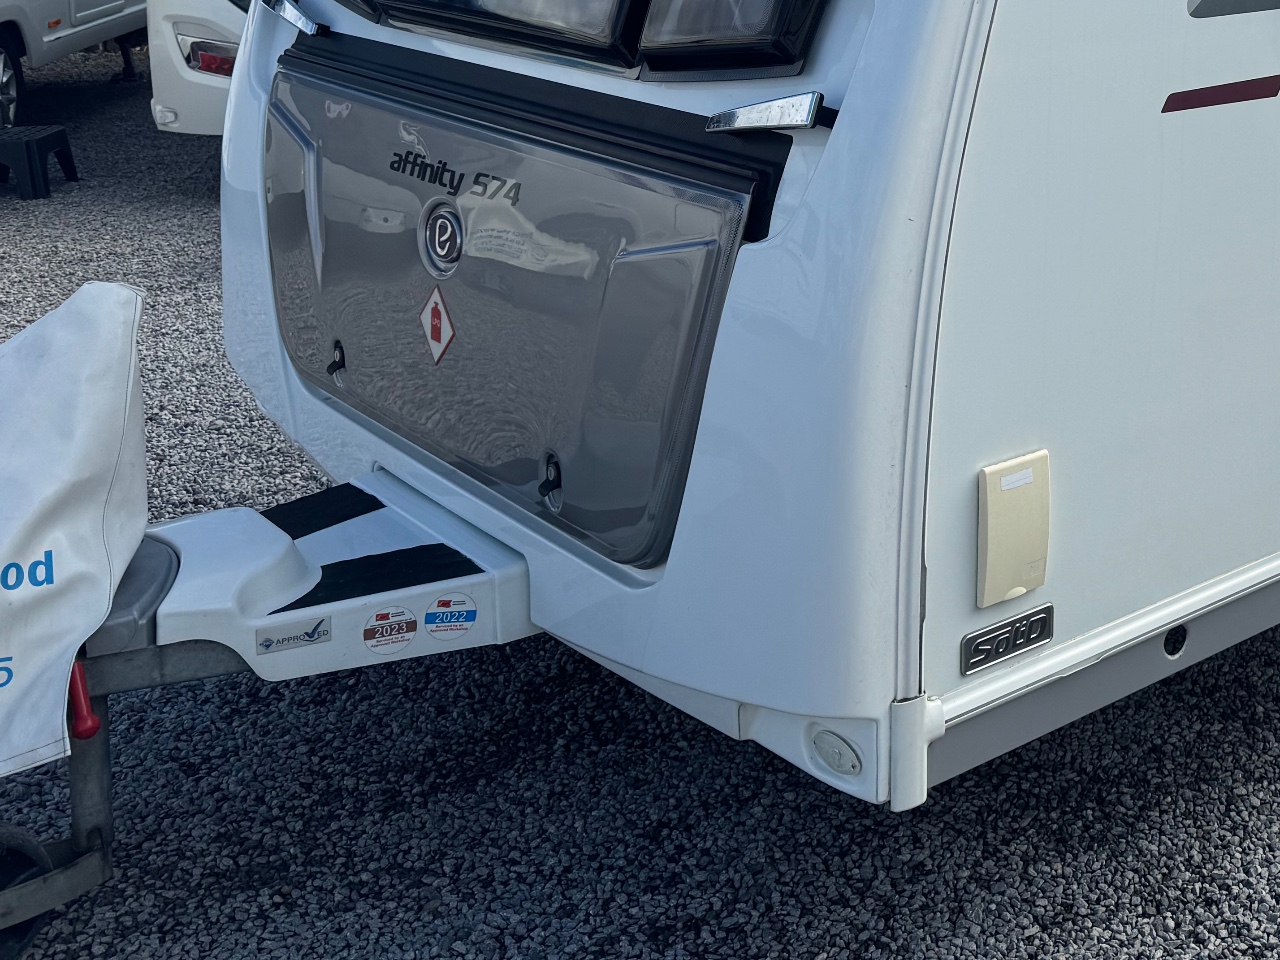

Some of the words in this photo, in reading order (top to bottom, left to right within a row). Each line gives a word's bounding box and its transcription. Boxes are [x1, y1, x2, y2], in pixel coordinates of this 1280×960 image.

[389, 150, 466, 196] affinity
[470, 172, 522, 207] 574
[435, 611, 467, 623] 2022
[374, 623, 407, 638] 2023
